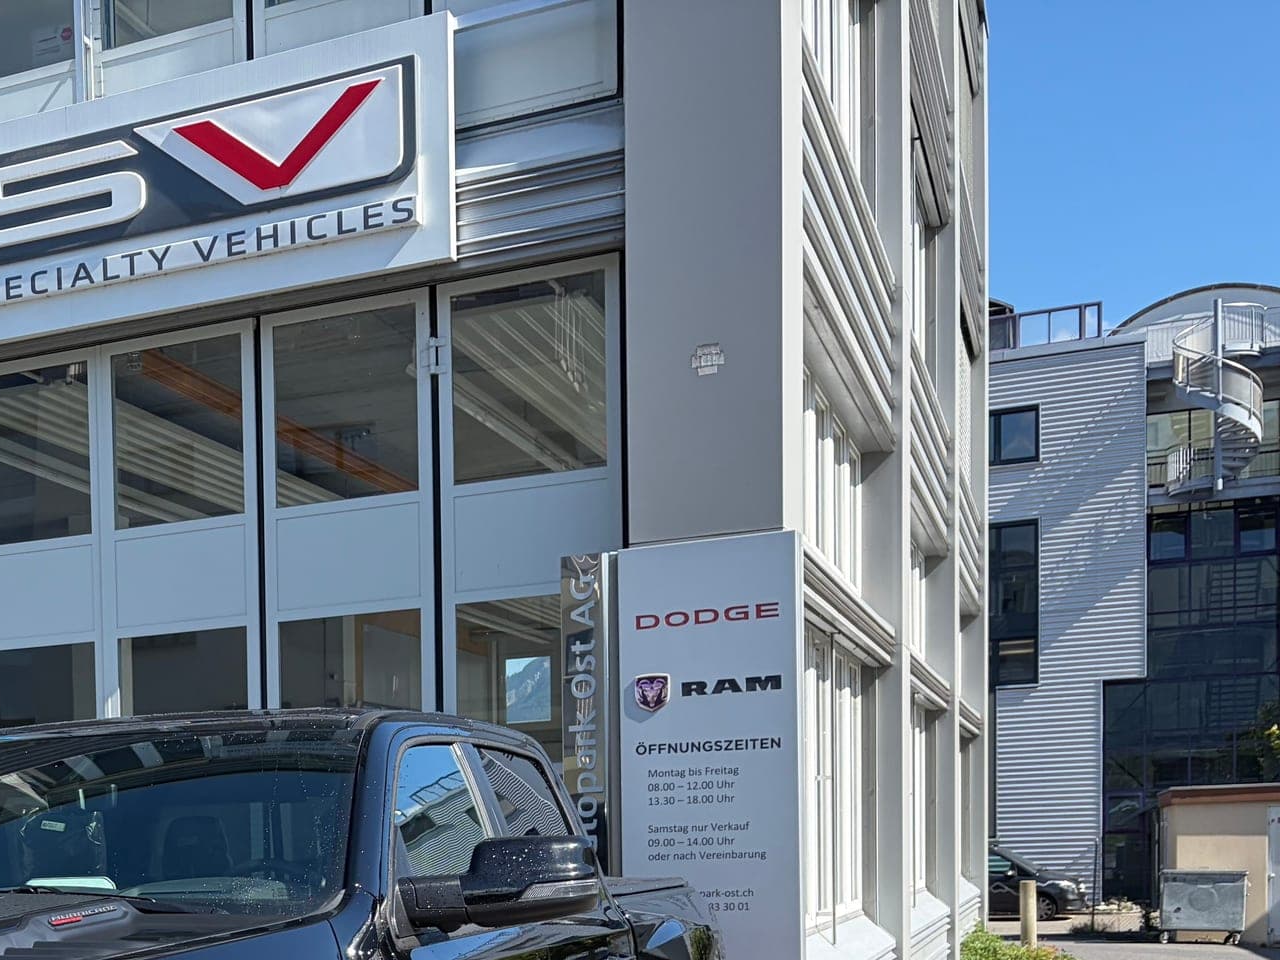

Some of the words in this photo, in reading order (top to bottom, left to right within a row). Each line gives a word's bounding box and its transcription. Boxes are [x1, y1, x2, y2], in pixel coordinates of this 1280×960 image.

[193, 196, 415, 263] VEHICLES
[570, 574, 596, 628] AG
[635, 602, 780, 631] DODGE
[570, 639, 597, 699] Ost
[681, 674, 782, 697] RAM
[635, 736, 782, 756] ÖFFNUNGSZEITEN
[648, 769, 686, 779] Montag
[688, 767, 702, 777] bis
[705, 766, 740, 777] Freitag
[648, 783, 675, 792] 08.00
[687, 781, 714, 790] 12.00
[716, 780, 735, 789] Uhr
[648, 796, 675, 806] 13.30
[687, 795, 714, 804] 18.00
[716, 794, 735, 803] Uhr
[648, 824, 689, 834] Samstag
[691, 823, 708, 832] nur
[711, 821, 750, 831] Verkauf
[648, 839, 675, 848] 09.00
[687, 837, 714, 846] 14.00
[716, 836, 735, 845] Uhr
[648, 852, 670, 861] oder
[673, 851, 696, 860] nach
[699, 850, 767, 860] Vereinbarung
[723, 902, 735, 911] 30
[738, 902, 749, 911] 01
